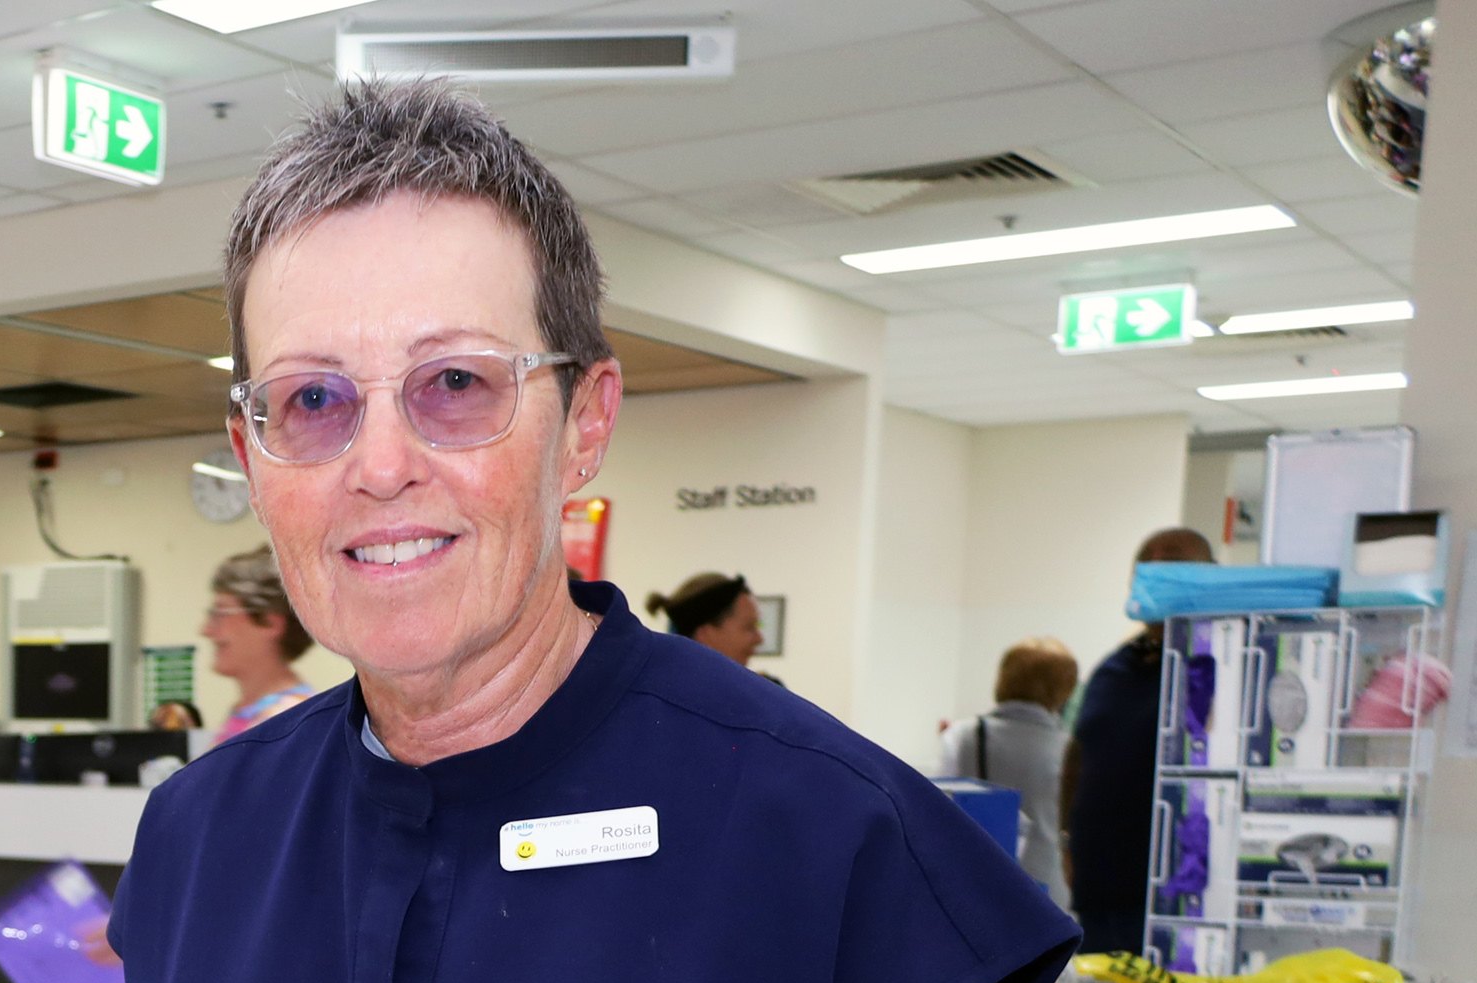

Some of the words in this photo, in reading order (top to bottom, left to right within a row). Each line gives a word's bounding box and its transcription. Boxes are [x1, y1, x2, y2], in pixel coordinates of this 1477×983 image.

[677, 486, 727, 509] Staff
[736, 484, 815, 506] Station
[549, 819, 572, 827] name
[601, 824, 651, 839] Rosita
[555, 849, 588, 857] Nurse
[591, 840, 652, 853] Practitioner
